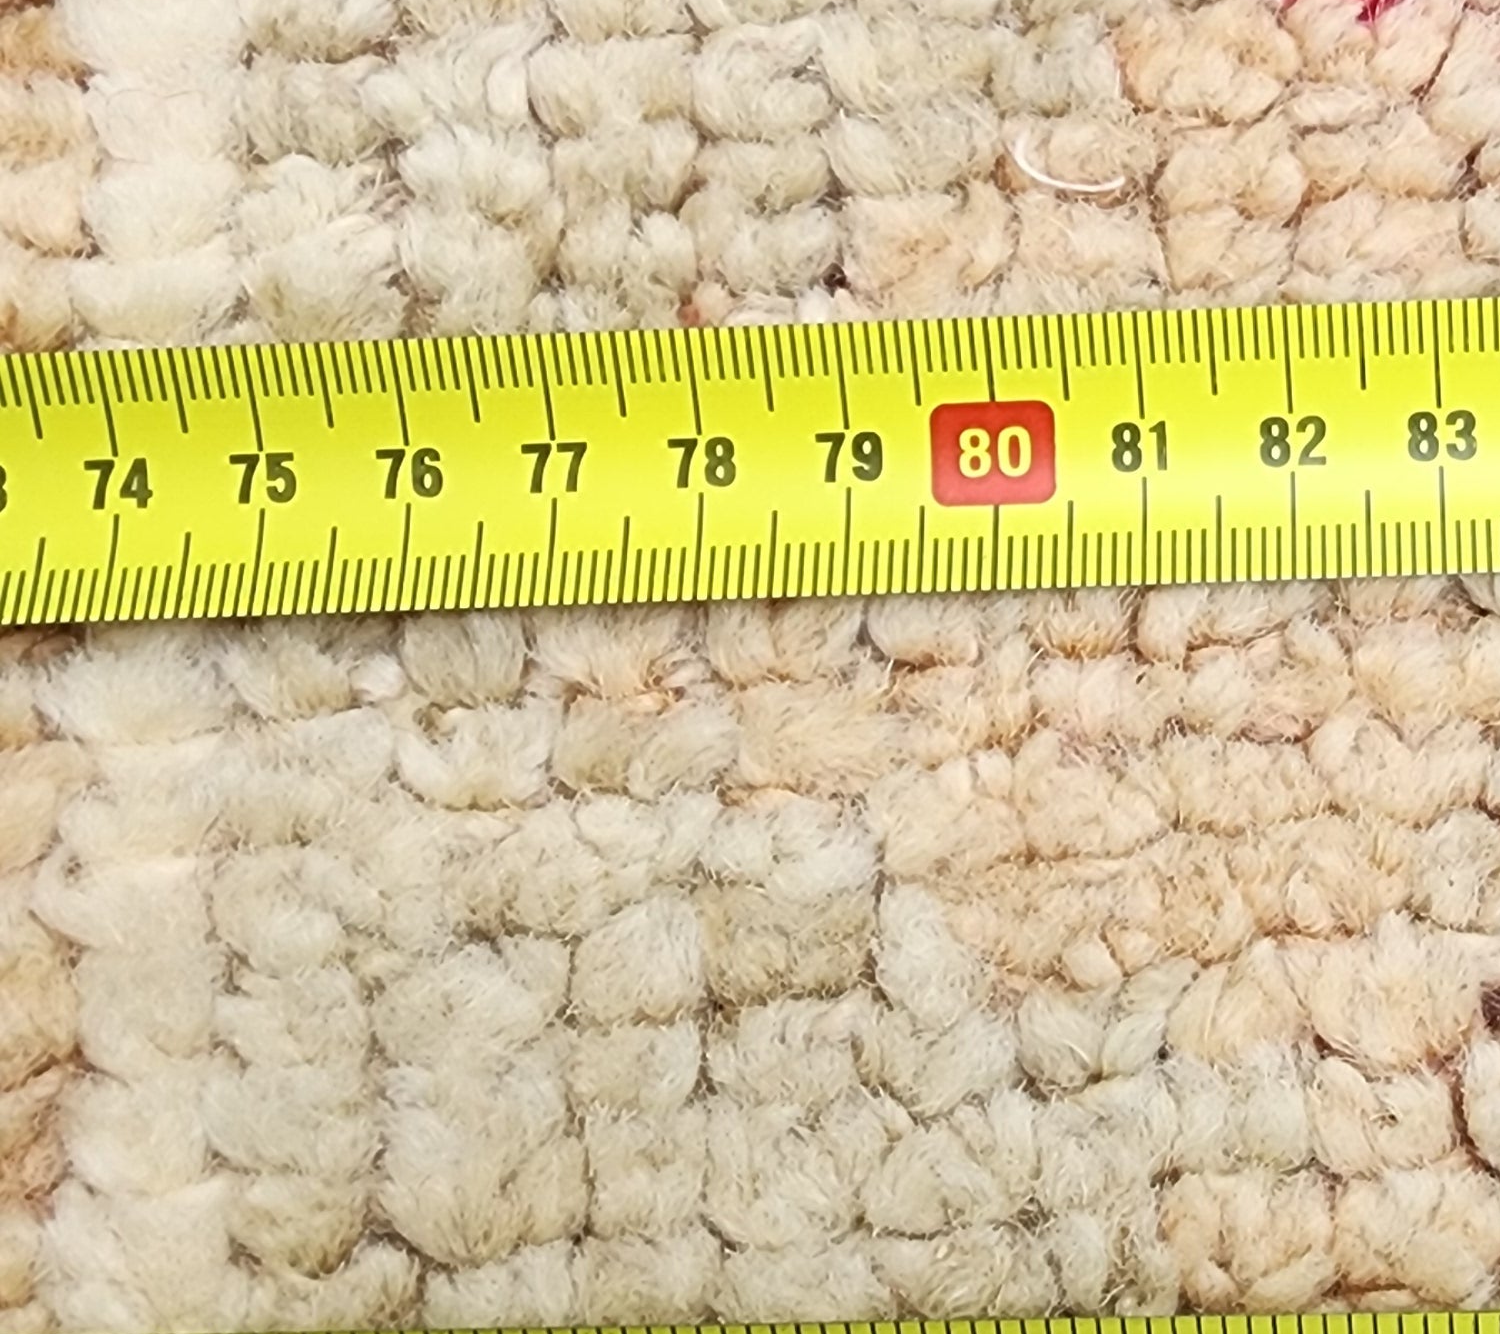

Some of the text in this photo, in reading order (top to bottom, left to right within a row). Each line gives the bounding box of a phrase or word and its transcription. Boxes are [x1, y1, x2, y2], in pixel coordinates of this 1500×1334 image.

[84, 459, 152, 509] 74
[229, 453, 297, 504] 75
[375, 448, 444, 499] 76
[521, 443, 589, 493] 77
[668, 438, 736, 488] 78
[815, 431, 884, 481] 79
[958, 427, 1032, 478] 80
[1112, 421, 1168, 472] 81
[1259, 416, 1326, 466] 82
[1408, 410, 1477, 461] 83
